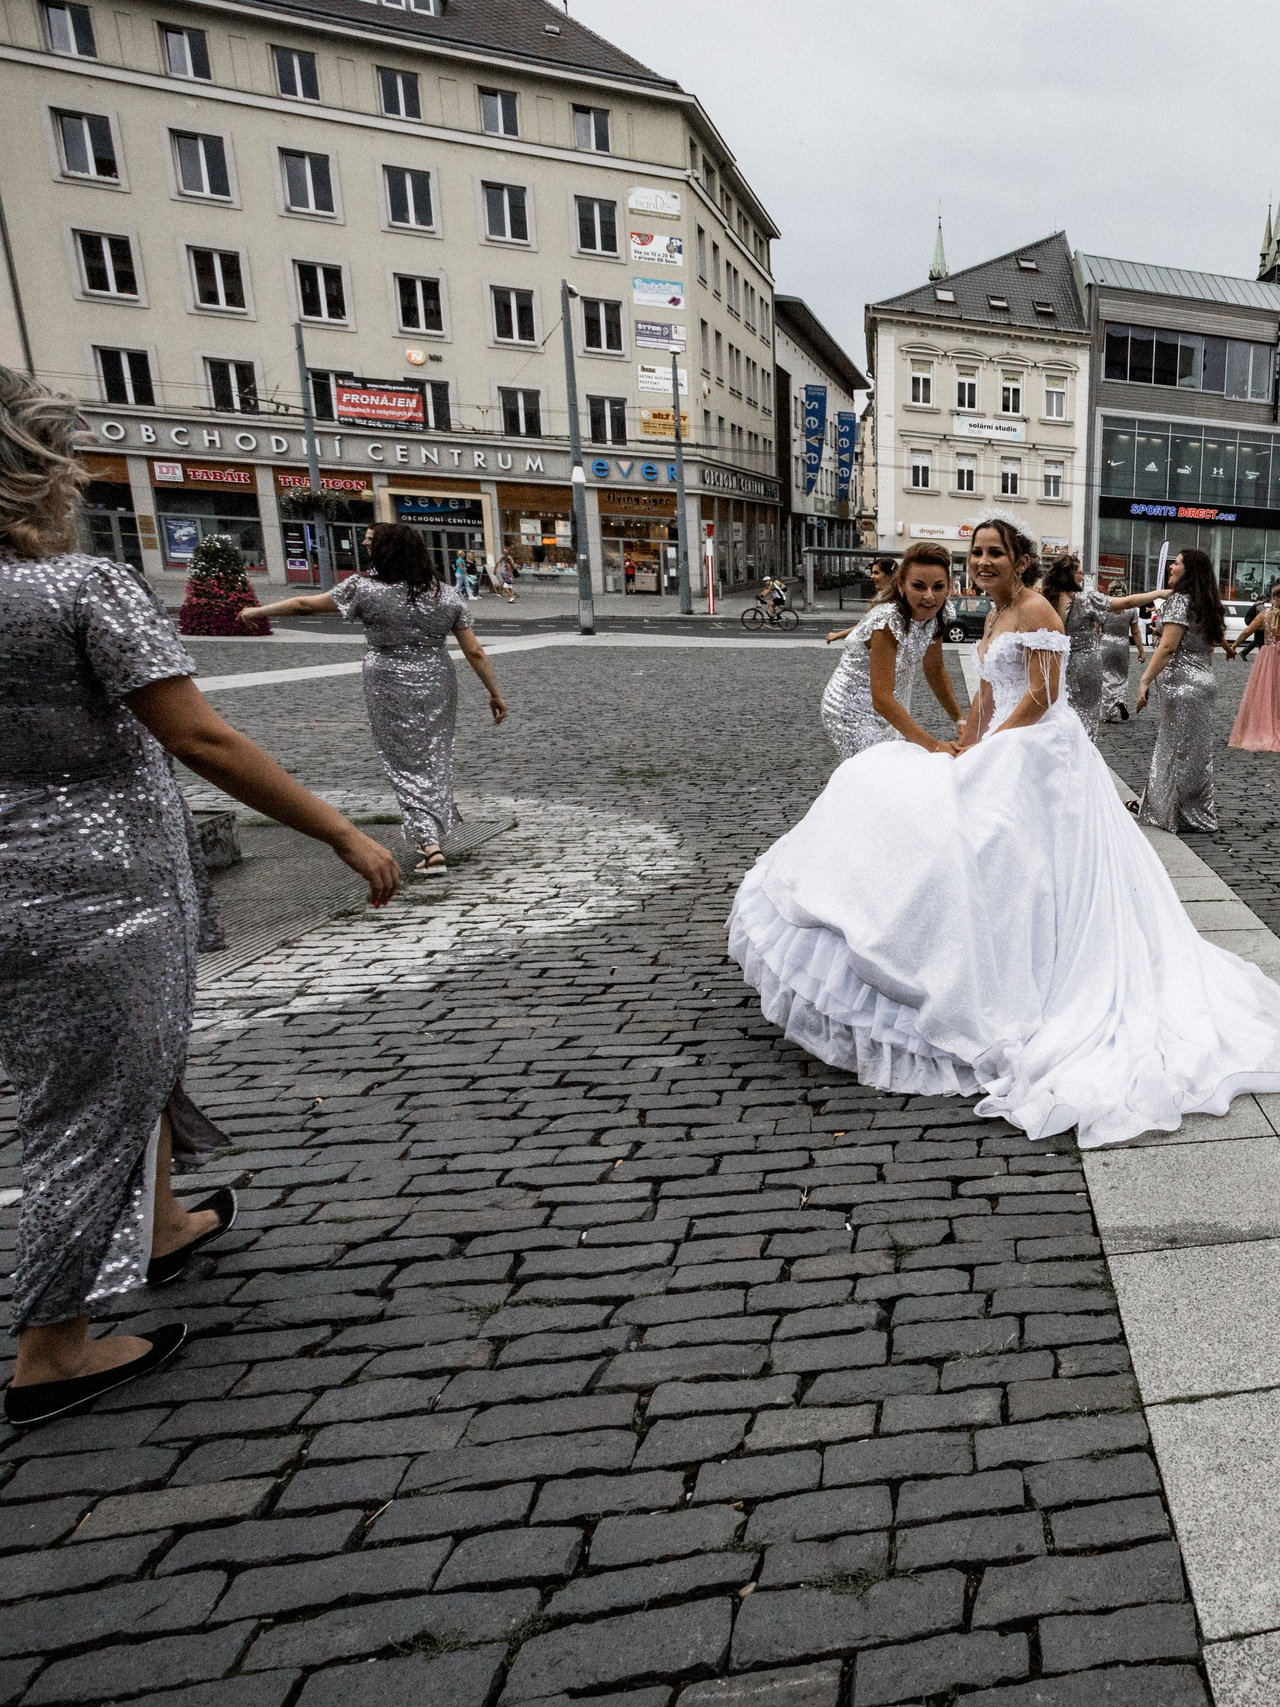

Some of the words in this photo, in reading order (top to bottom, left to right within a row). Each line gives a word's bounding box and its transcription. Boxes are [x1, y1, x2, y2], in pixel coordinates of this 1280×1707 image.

[342, 393, 417, 408] PRONÁJEM
[376, 409, 407, 417] nebytových
[408, 410, 423, 418] ploch
[968, 422, 994, 430] solární
[995, 424, 1017, 433] studio
[101, 421, 342, 457] OBCHODNÍ
[367, 443, 544, 472] CENTRUM
[187, 469, 250, 483] TABÁK
[278, 475, 367, 491] TRAICON
[607, 492, 641, 505] flying
[642, 496, 671, 507] tiger
[401, 515, 443, 523] OBCHODNÍ
[919, 527, 945, 535] drogerie
